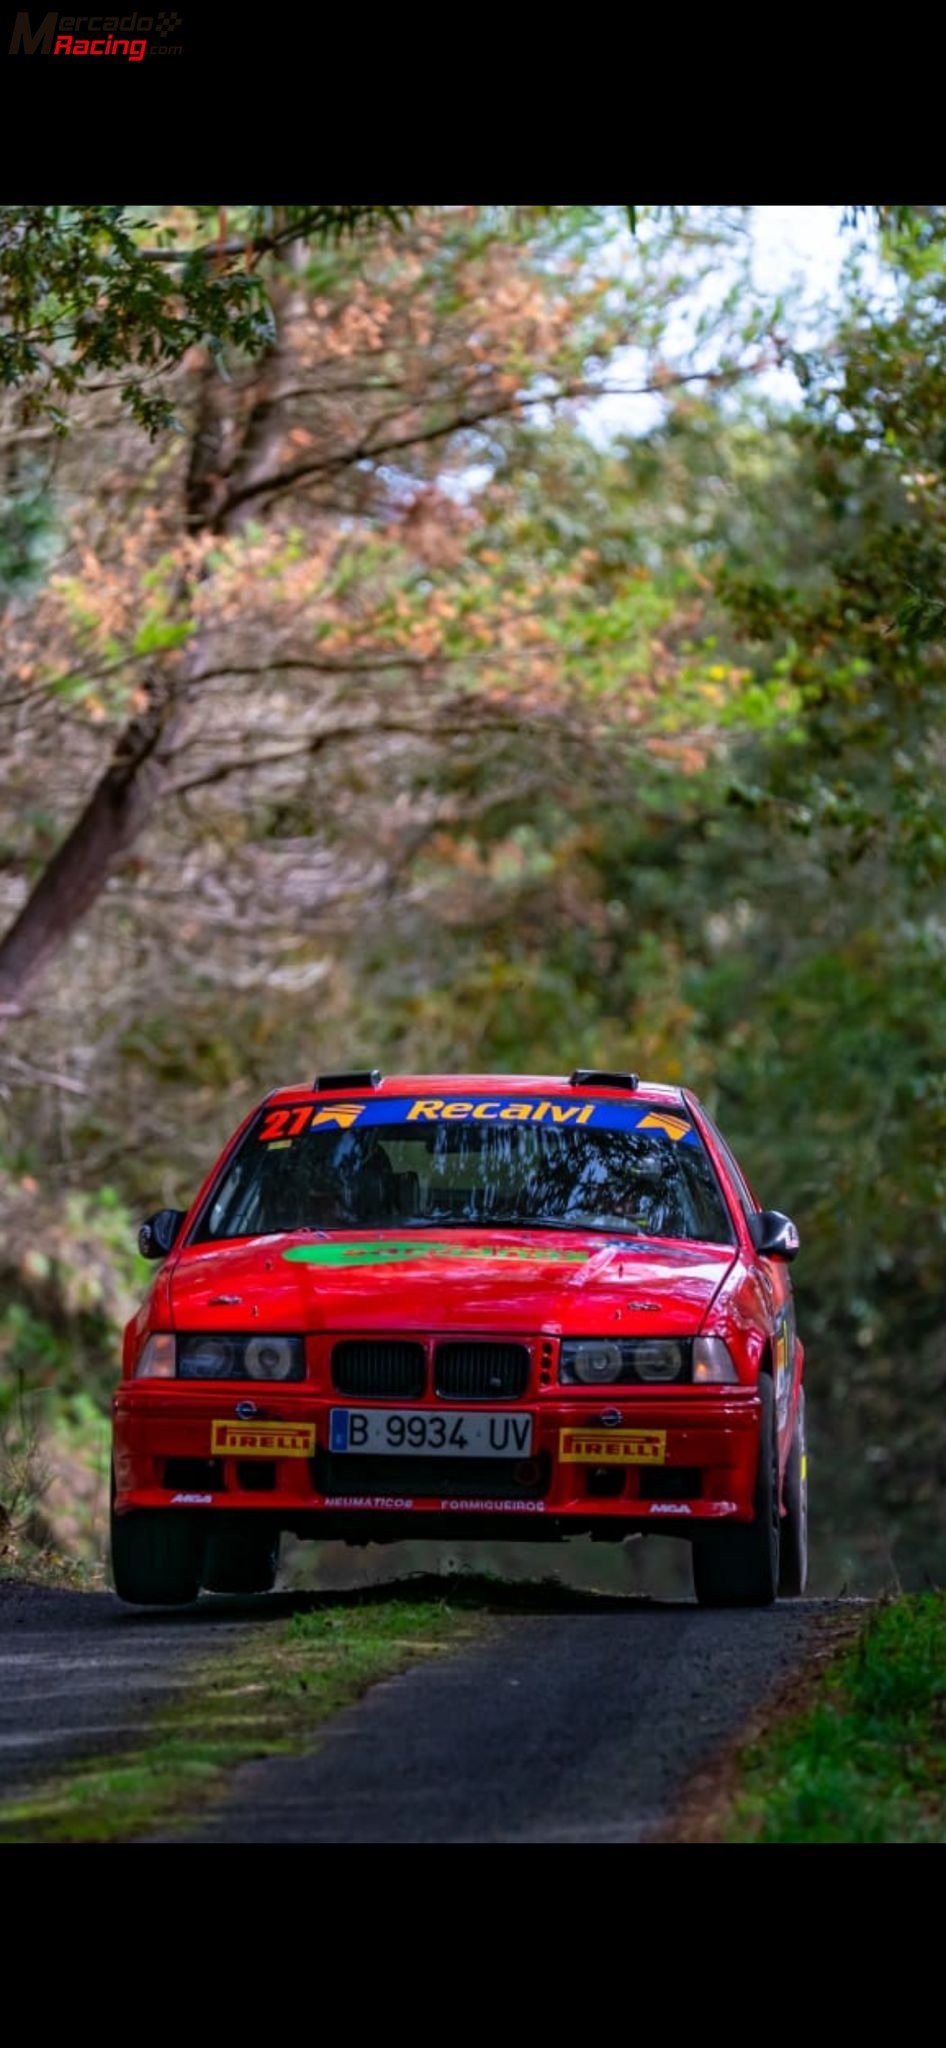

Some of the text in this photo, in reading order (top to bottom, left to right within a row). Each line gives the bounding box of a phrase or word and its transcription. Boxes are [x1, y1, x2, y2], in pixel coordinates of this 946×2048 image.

[406, 1100, 596, 1124] Recalvi
[215, 1425, 311, 1450] PIRELLI
[349, 1413, 530, 1451] B 9934 UV
[562, 1434, 661, 1457] PIRELLI
